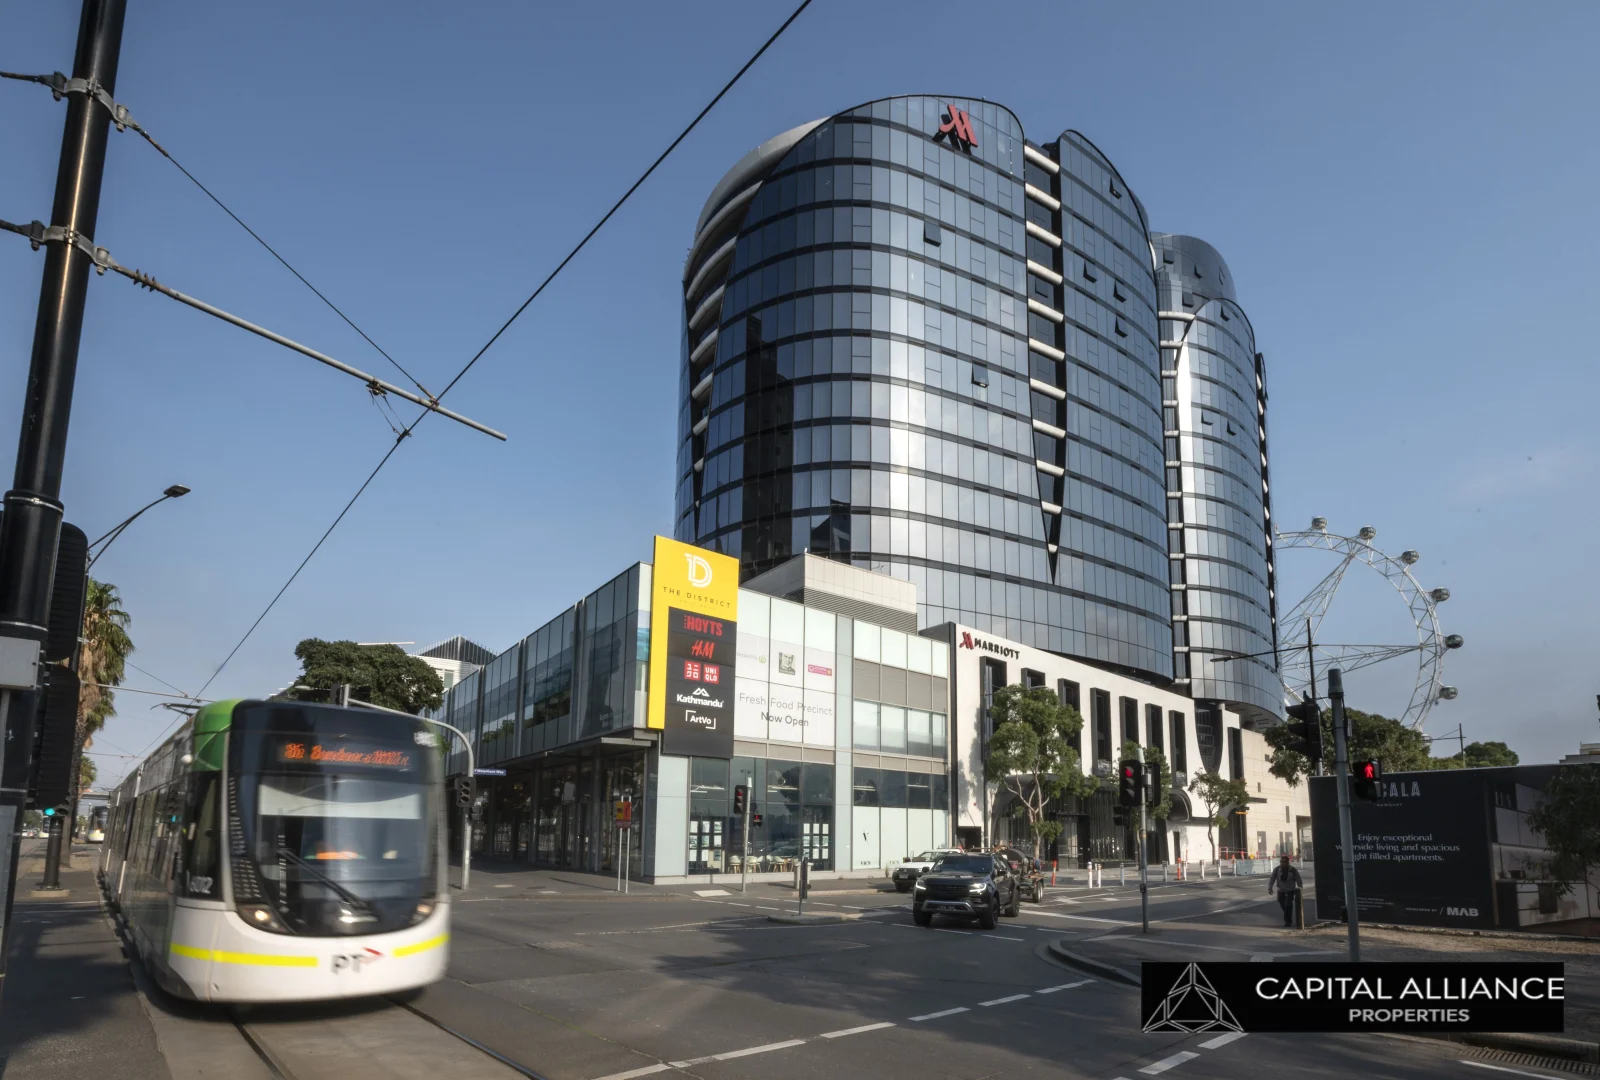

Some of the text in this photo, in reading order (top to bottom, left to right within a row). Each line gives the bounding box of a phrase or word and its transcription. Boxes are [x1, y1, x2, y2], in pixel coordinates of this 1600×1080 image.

[663, 586, 681, 597] THE
[686, 592, 731, 608] DISTRICT
[685, 615, 723, 637] HOYTS
[691, 639, 716, 659] H&M
[974, 638, 1020, 660] MARRIOTT
[705, 666, 717, 675] UNI
[676, 693, 724, 709] Kathmandu
[739, 692, 833, 716] Fresh Food Precinct
[690, 714, 712, 725] ArtVo
[761, 711, 809, 727] Now Open
[1357, 833, 1433, 843] Enjoy exceptional
[1376, 843, 1400, 853] living
[1401, 843, 1418, 852] and
[1420, 845, 1460, 853] spacious
[1369, 852, 1390, 861] filled
[1392, 854, 1445, 862] apartments.
[1446, 907, 1479, 917] MAB
